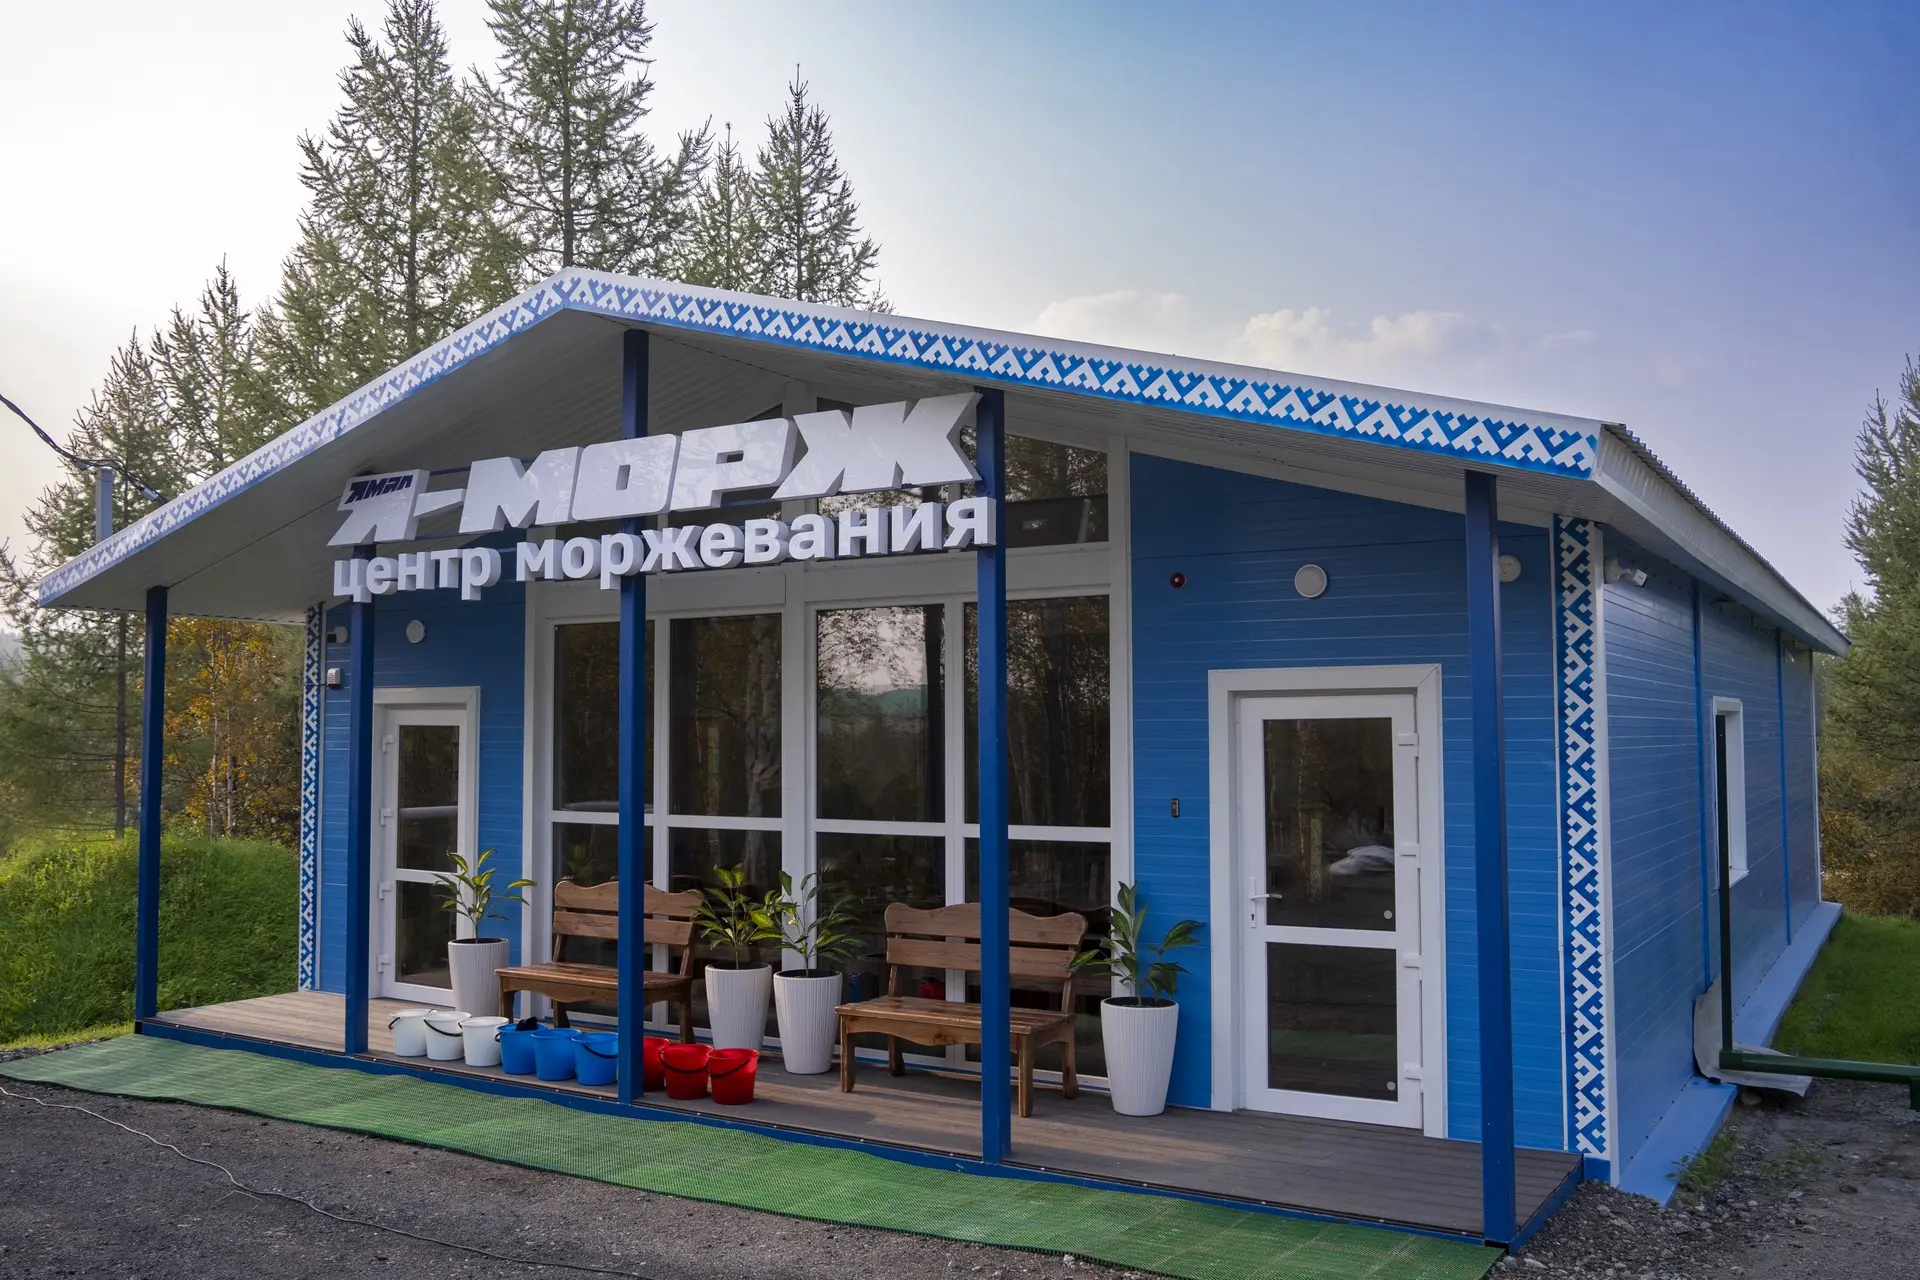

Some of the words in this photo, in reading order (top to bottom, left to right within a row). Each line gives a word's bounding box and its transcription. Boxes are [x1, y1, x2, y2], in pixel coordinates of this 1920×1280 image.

[327, 393, 982, 546] Я-МОРЖ
[333, 547, 500, 603] центр
[516, 497, 996, 589] моржевания
